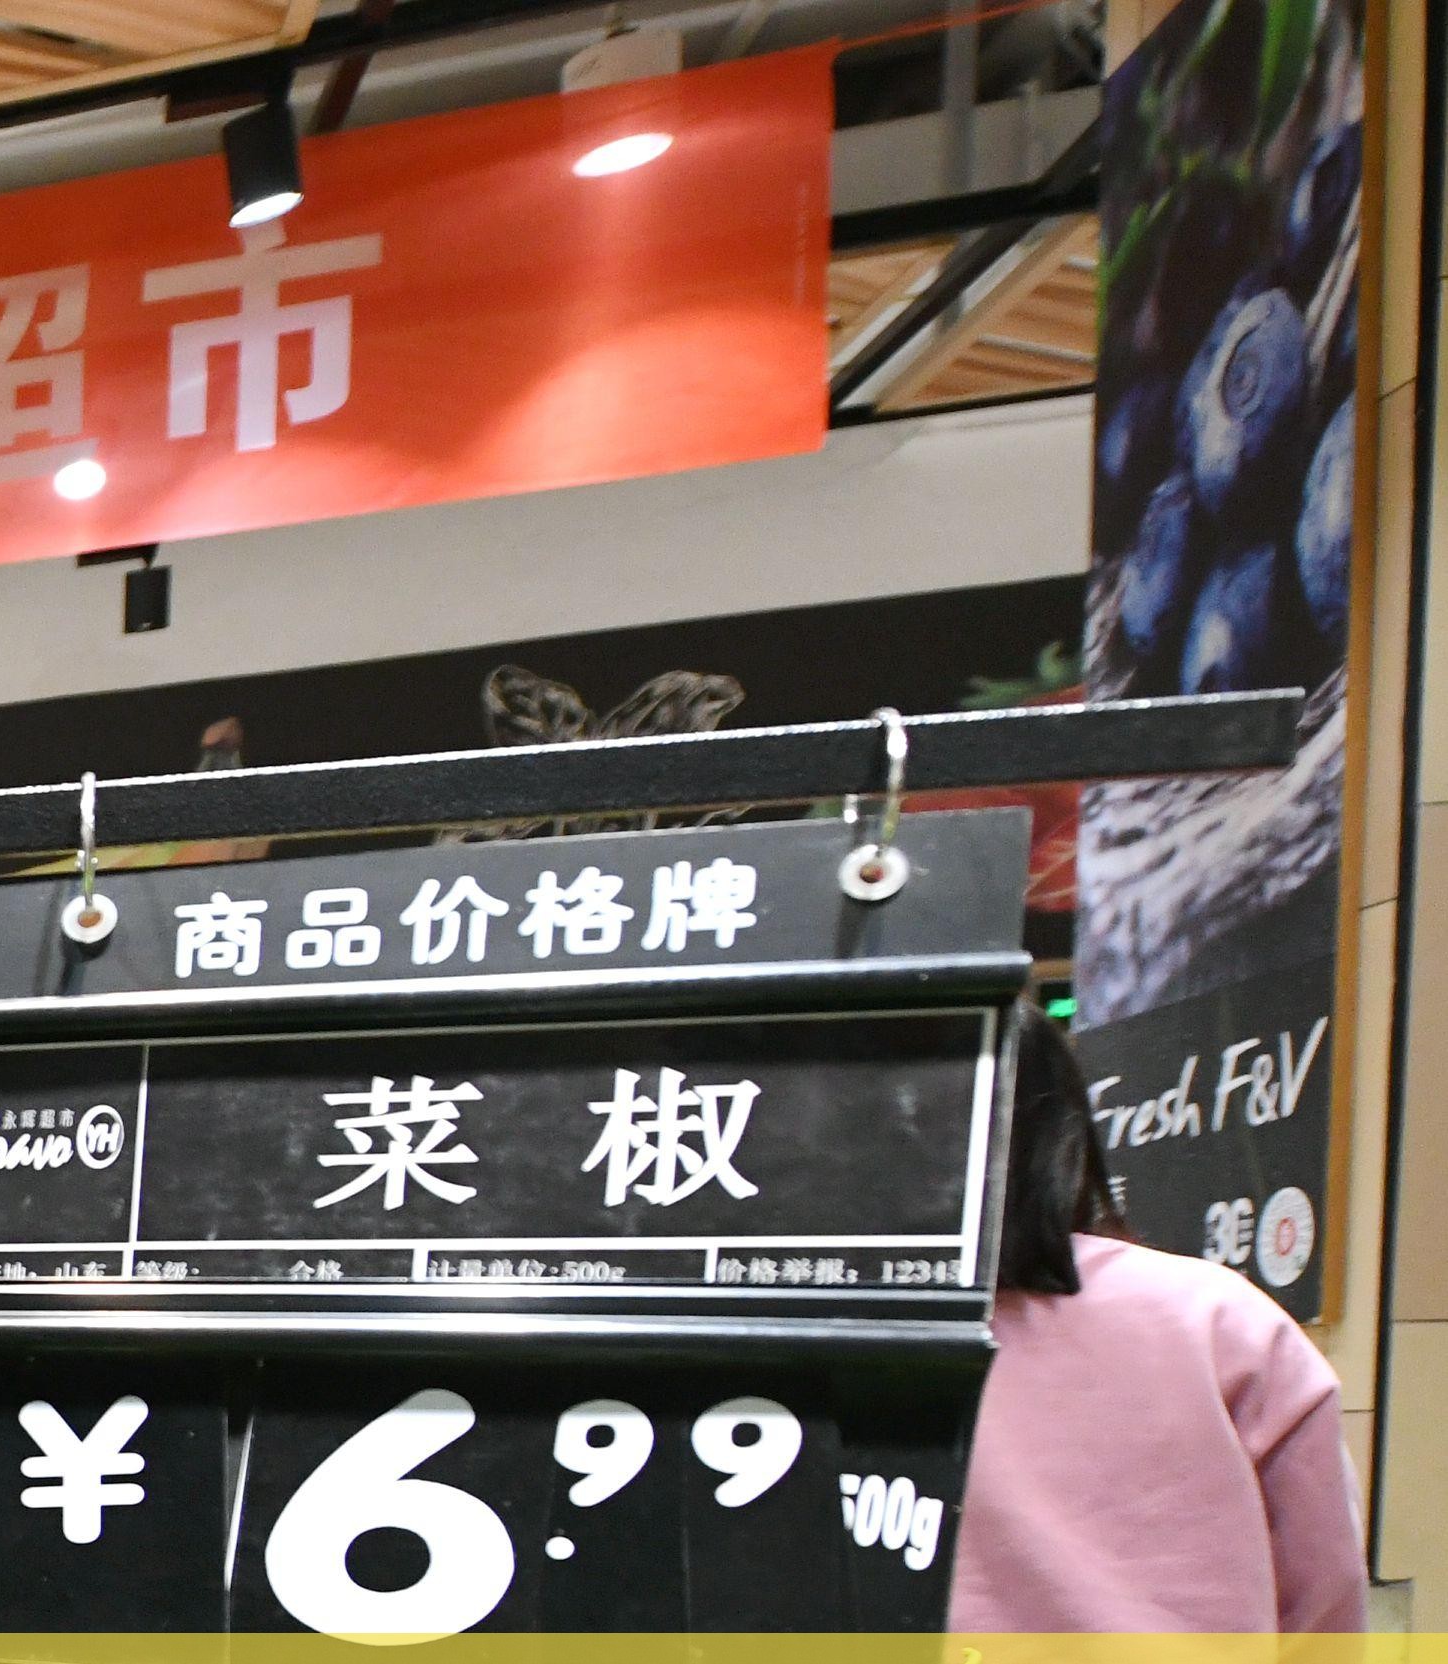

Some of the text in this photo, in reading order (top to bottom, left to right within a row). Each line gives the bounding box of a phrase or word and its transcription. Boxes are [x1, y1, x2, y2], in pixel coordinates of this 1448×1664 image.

[173, 857, 759, 979] 商品价格牌
[312, 1066, 763, 1212] 菜椒
[1088, 1015, 1329, 1150] Fresh F&V
[17, 1395, 150, 1545] ¥
[264, 1388, 805, 1647] 6.99
